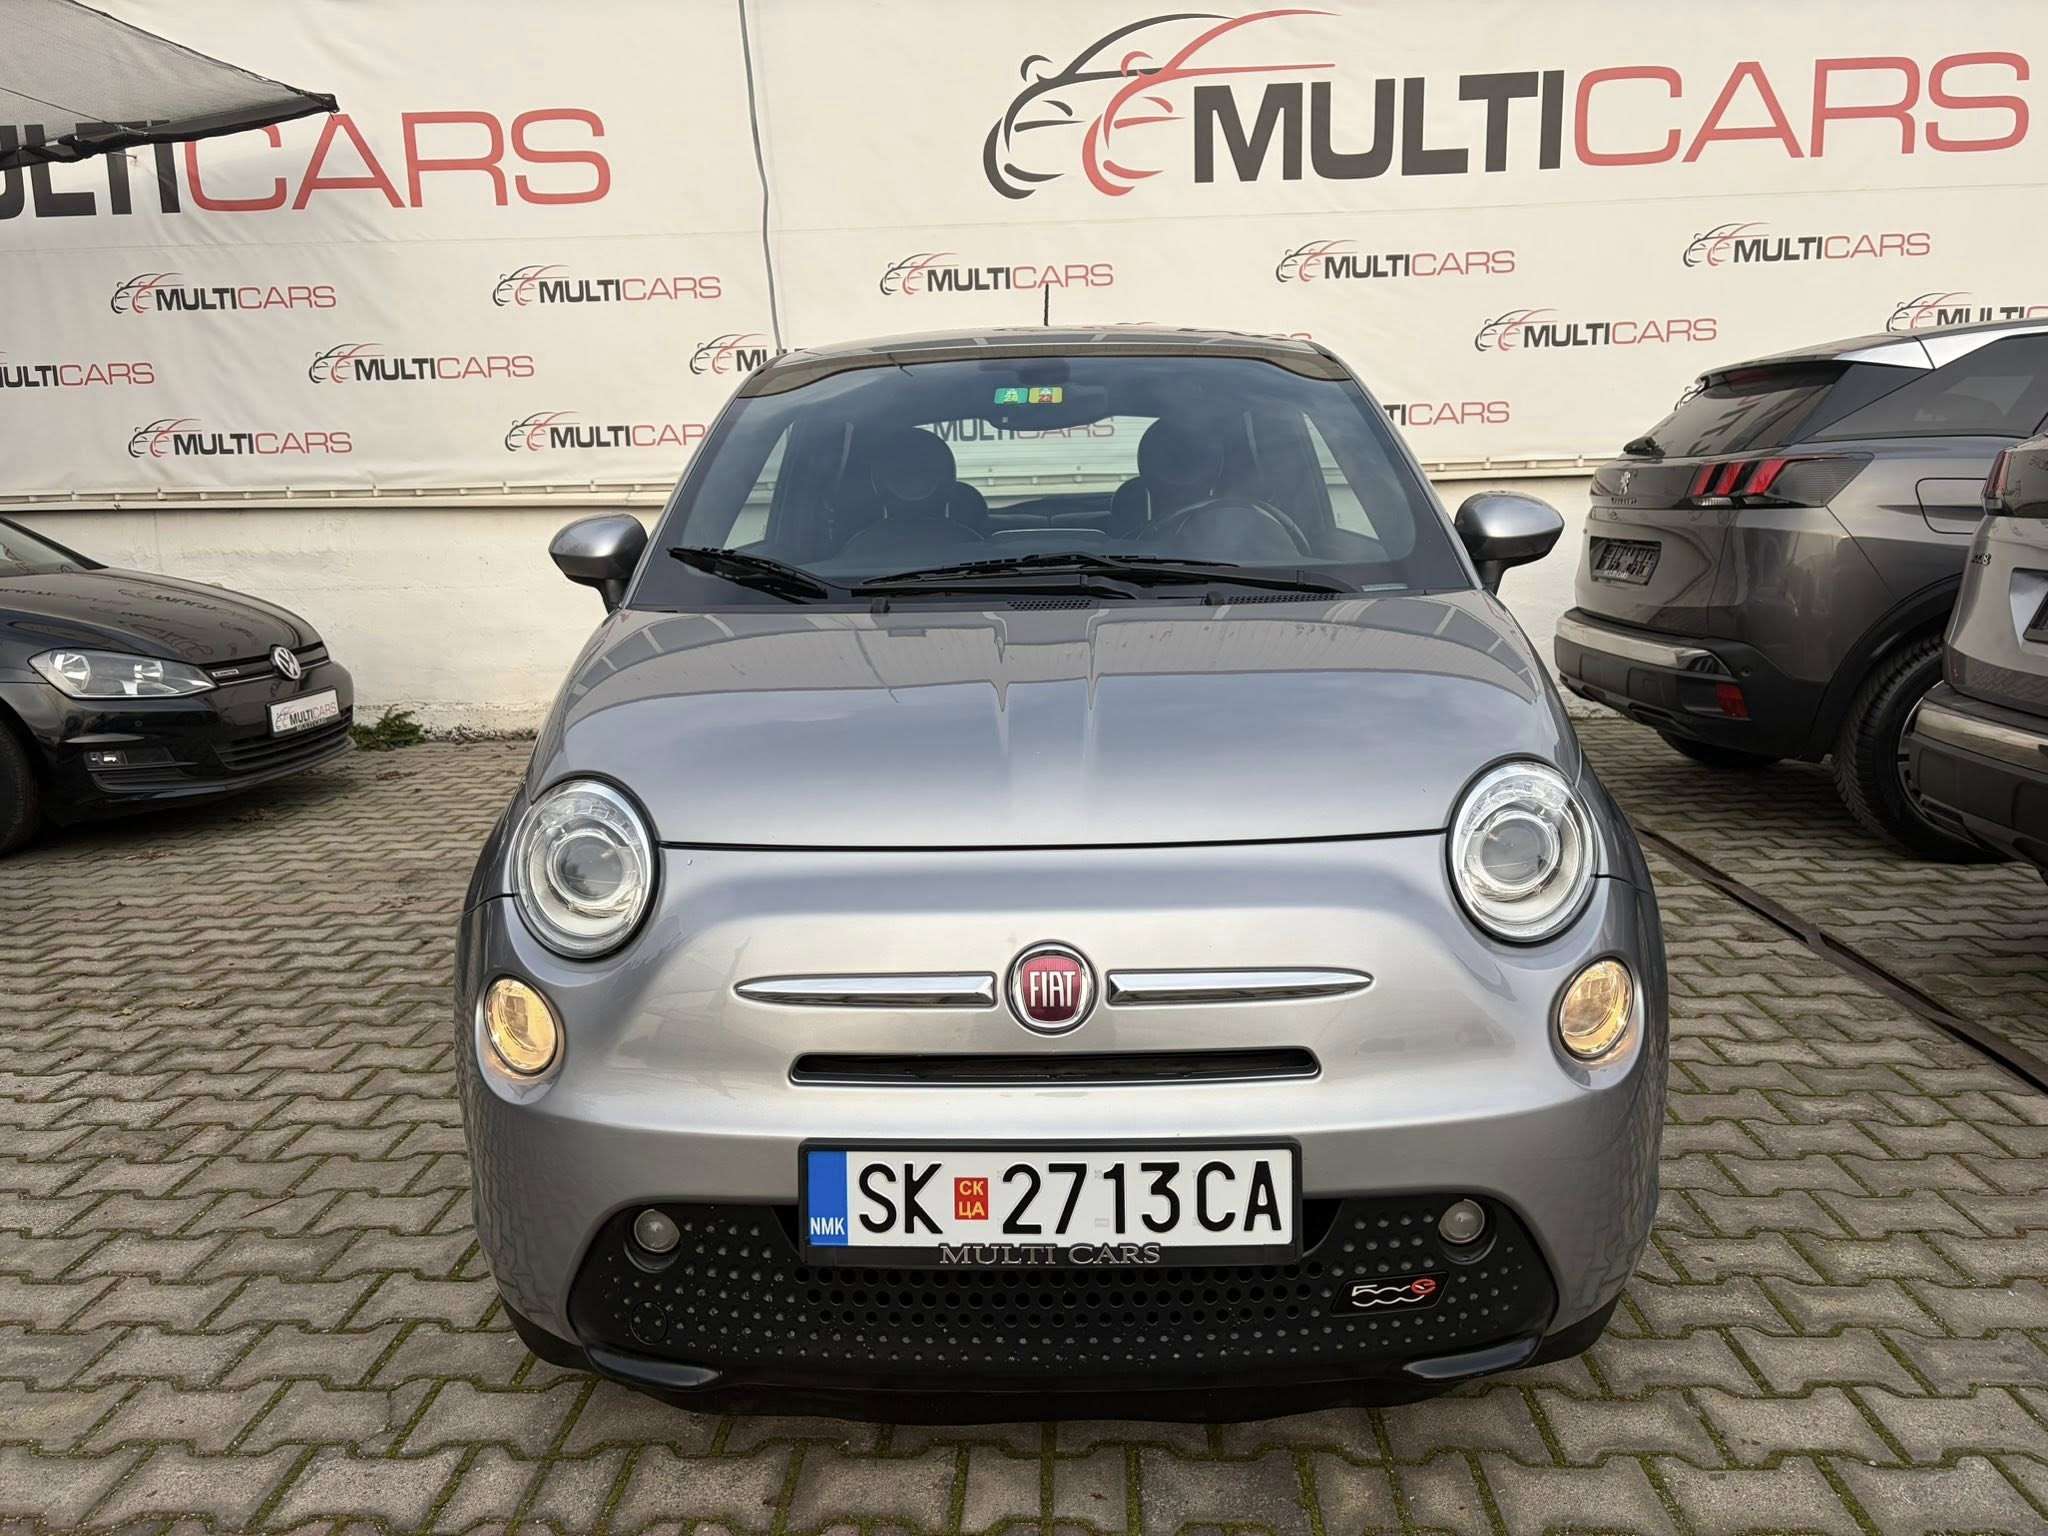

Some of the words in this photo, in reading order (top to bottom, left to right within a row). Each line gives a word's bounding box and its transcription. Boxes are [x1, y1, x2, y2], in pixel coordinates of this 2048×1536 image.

[1194, 52, 2030, 183] MULTICARS
[1734, 233, 1931, 263] MULTICARS
[927, 264, 1114, 293] MULTICARS
[1324, 250, 1516, 280] MULTICARS
[156, 285, 337, 312] MULTICARS
[539, 276, 722, 305] MULTICARS
[1523, 318, 1718, 349] MULTICARS
[0, 362, 155, 389] ULTICARS
[355, 355, 535, 382] MULTICARS
[1383, 400, 1510, 426] TICARS
[173, 431, 353, 456] MULTICARS
[550, 424, 712, 449] MULTICAR
[289, 702, 337, 726] MULTICARS
[1029, 970, 1076, 1008] FIAT
[858, 1162, 944, 1235] SK
[810, 1217, 846, 1235] NMK
[939, 1243, 1056, 1265] MULTI
[1069, 1242, 1162, 1265] CARS
